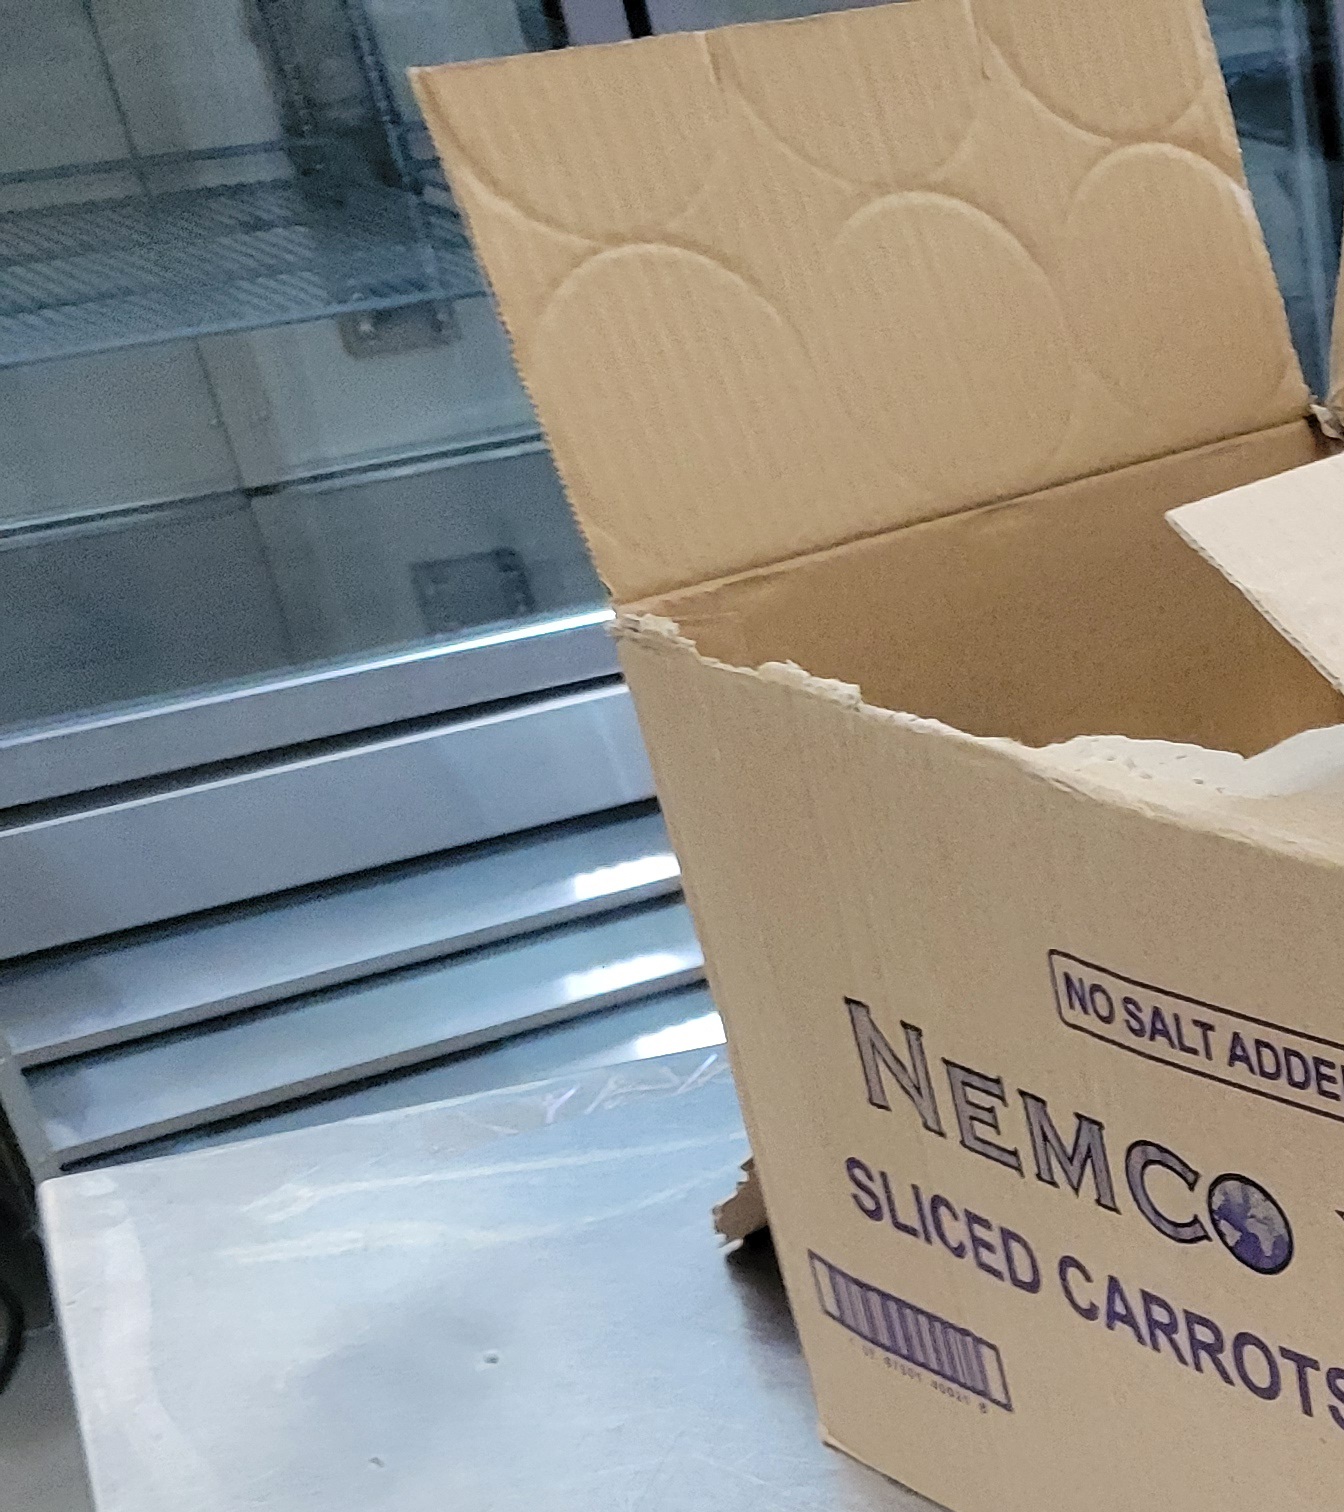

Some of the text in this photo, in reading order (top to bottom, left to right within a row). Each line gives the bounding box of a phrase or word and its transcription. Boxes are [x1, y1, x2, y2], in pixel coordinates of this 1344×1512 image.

[1063, 970, 1116, 1025] NO
[1121, 995, 1216, 1062] SALT
[843, 995, 1296, 1276] NEMCO
[844, 1155, 1042, 1296] SLICED
